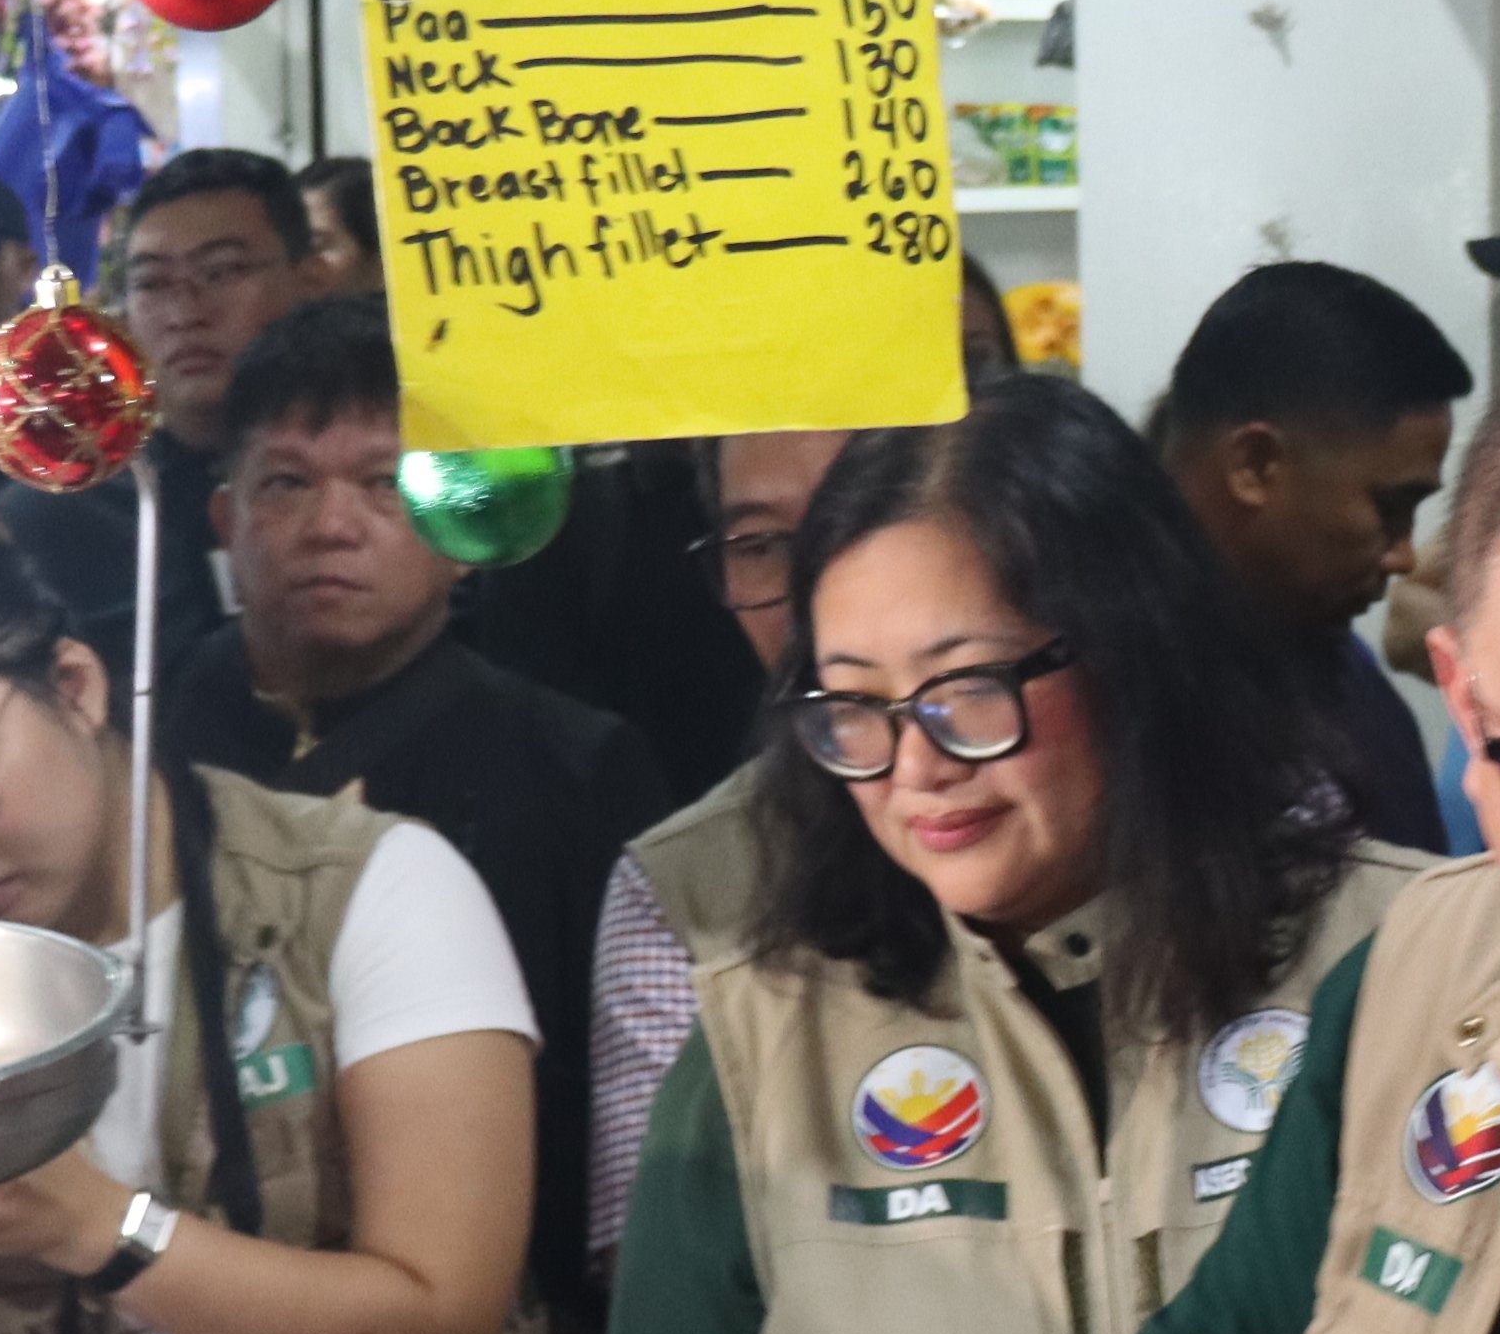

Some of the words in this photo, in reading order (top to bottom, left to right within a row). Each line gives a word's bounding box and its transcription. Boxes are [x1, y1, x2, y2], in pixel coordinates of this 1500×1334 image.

[385, 49, 514, 98] Neck
[836, 38, 919, 98] 130
[384, 106, 524, 154] Back
[531, 99, 646, 147] Bone
[842, 96, 928, 150] 140
[398, 164, 567, 214] Breast
[842, 149, 938, 202] 260
[400, 220, 579, 317] Thigh
[586, 209, 725, 280] fillet
[866, 210, 951, 265] 280
[887, 1182, 952, 1221] DA
